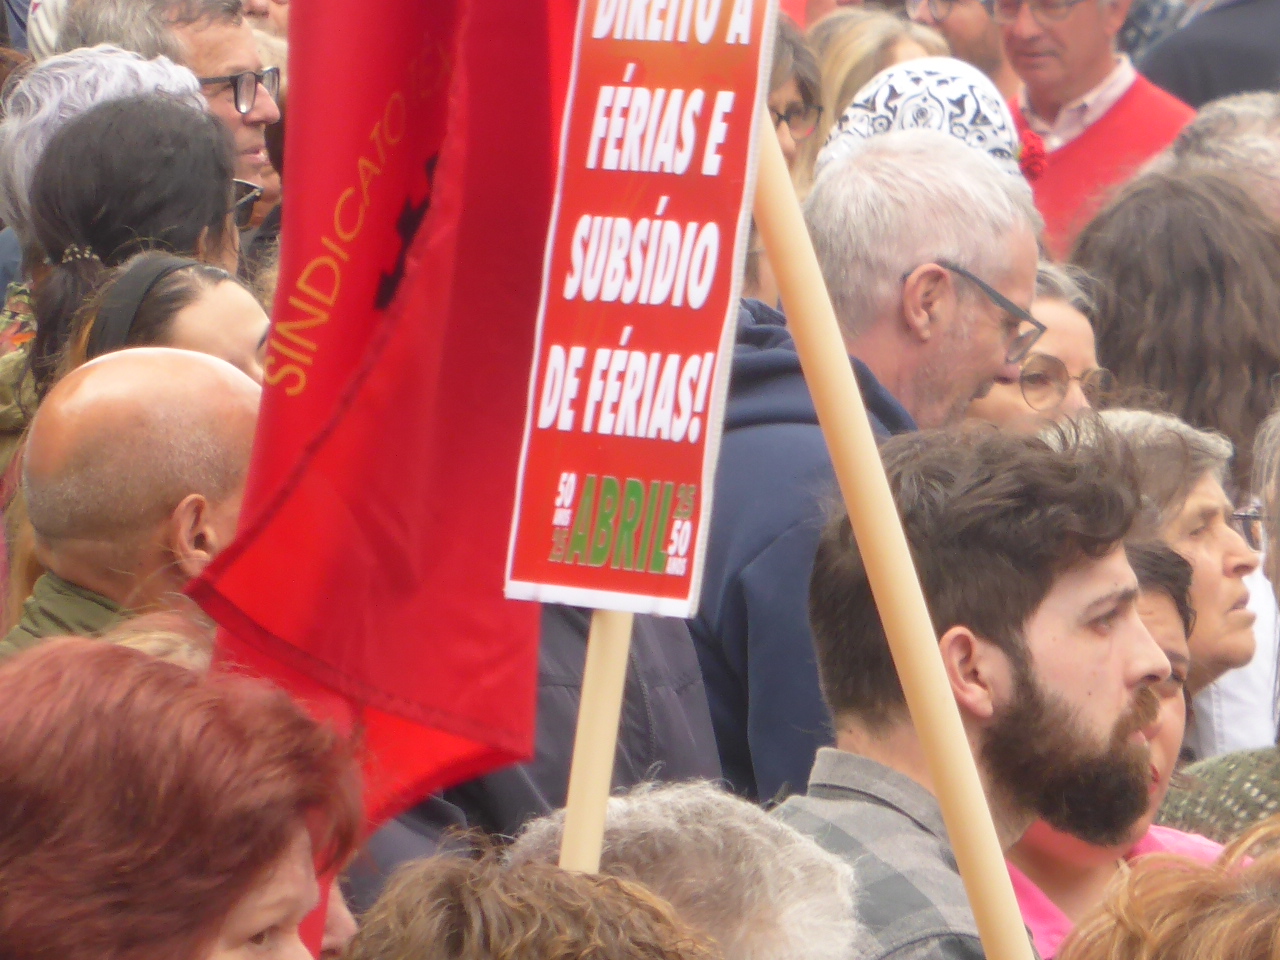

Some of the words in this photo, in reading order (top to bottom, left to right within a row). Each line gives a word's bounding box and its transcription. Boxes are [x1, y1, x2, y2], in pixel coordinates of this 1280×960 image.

[586, 63, 705, 174] FÉRIAS
[701, 91, 735, 176] E
[264, 91, 405, 397] SINDICATO
[563, 196, 719, 310] SUBSÍDIO
[538, 345, 588, 431] DE
[582, 326, 715, 444] FÉRIAS!
[555, 472, 577, 508] 50
[565, 474, 674, 574] ABRIL
[667, 520, 692, 557] 50
